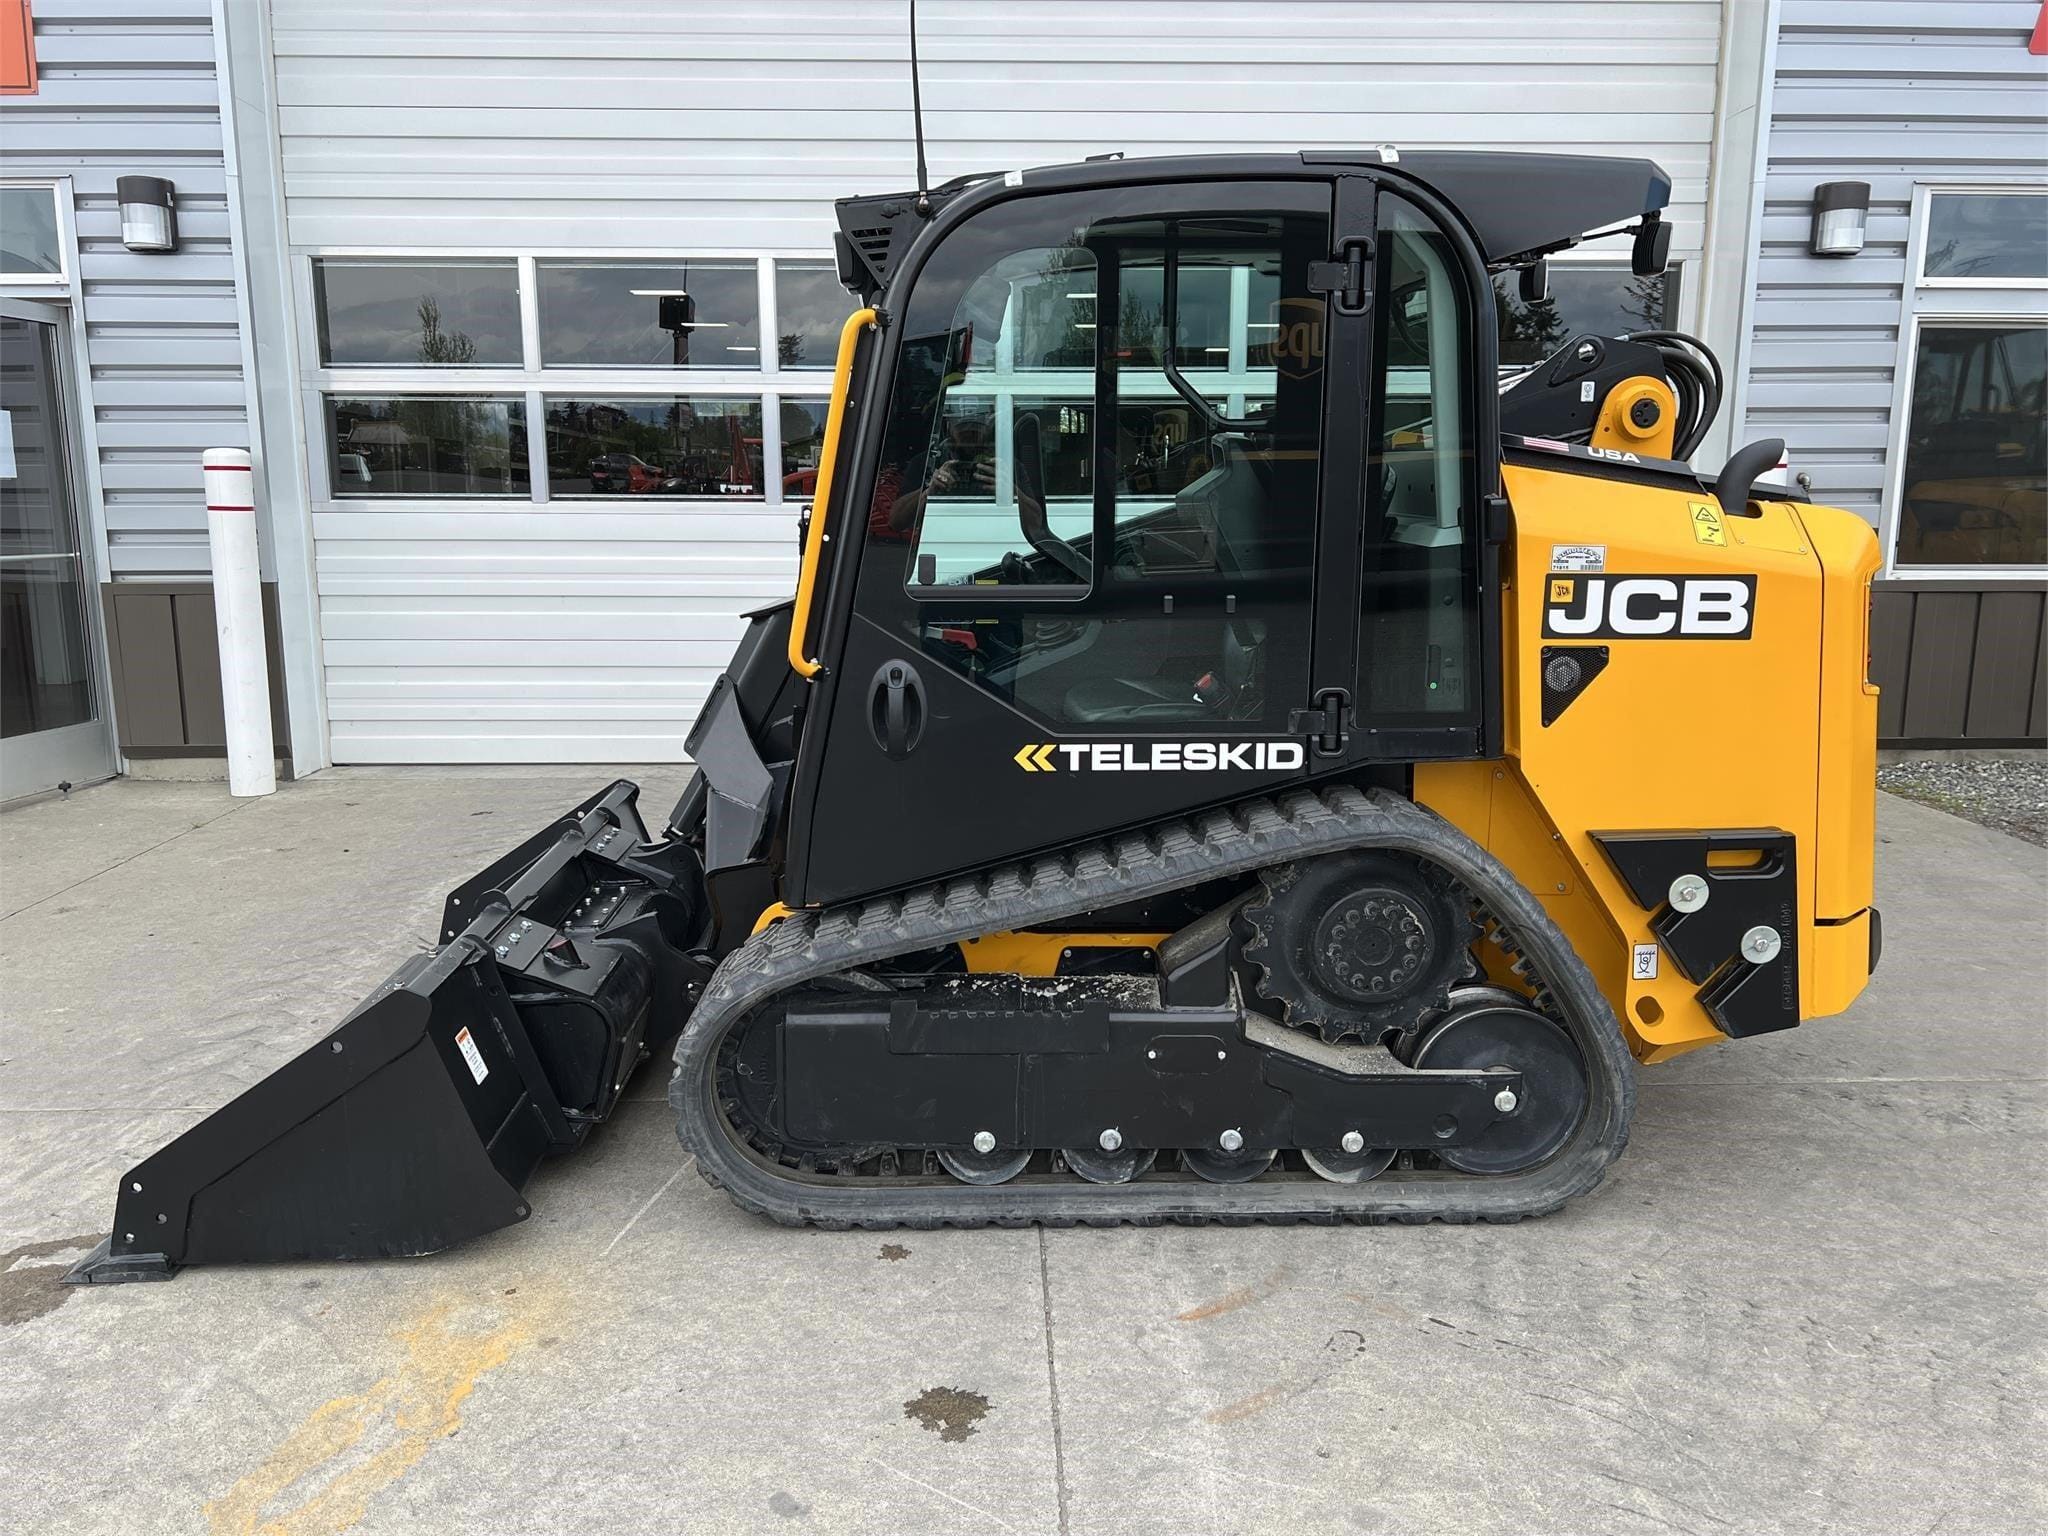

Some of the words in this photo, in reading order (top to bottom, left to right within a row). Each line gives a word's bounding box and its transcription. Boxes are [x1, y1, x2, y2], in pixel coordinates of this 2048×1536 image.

[1587, 446, 1641, 464] USA
[1549, 579, 1749, 634] JCB
[1059, 743, 1304, 771] TELESKID
